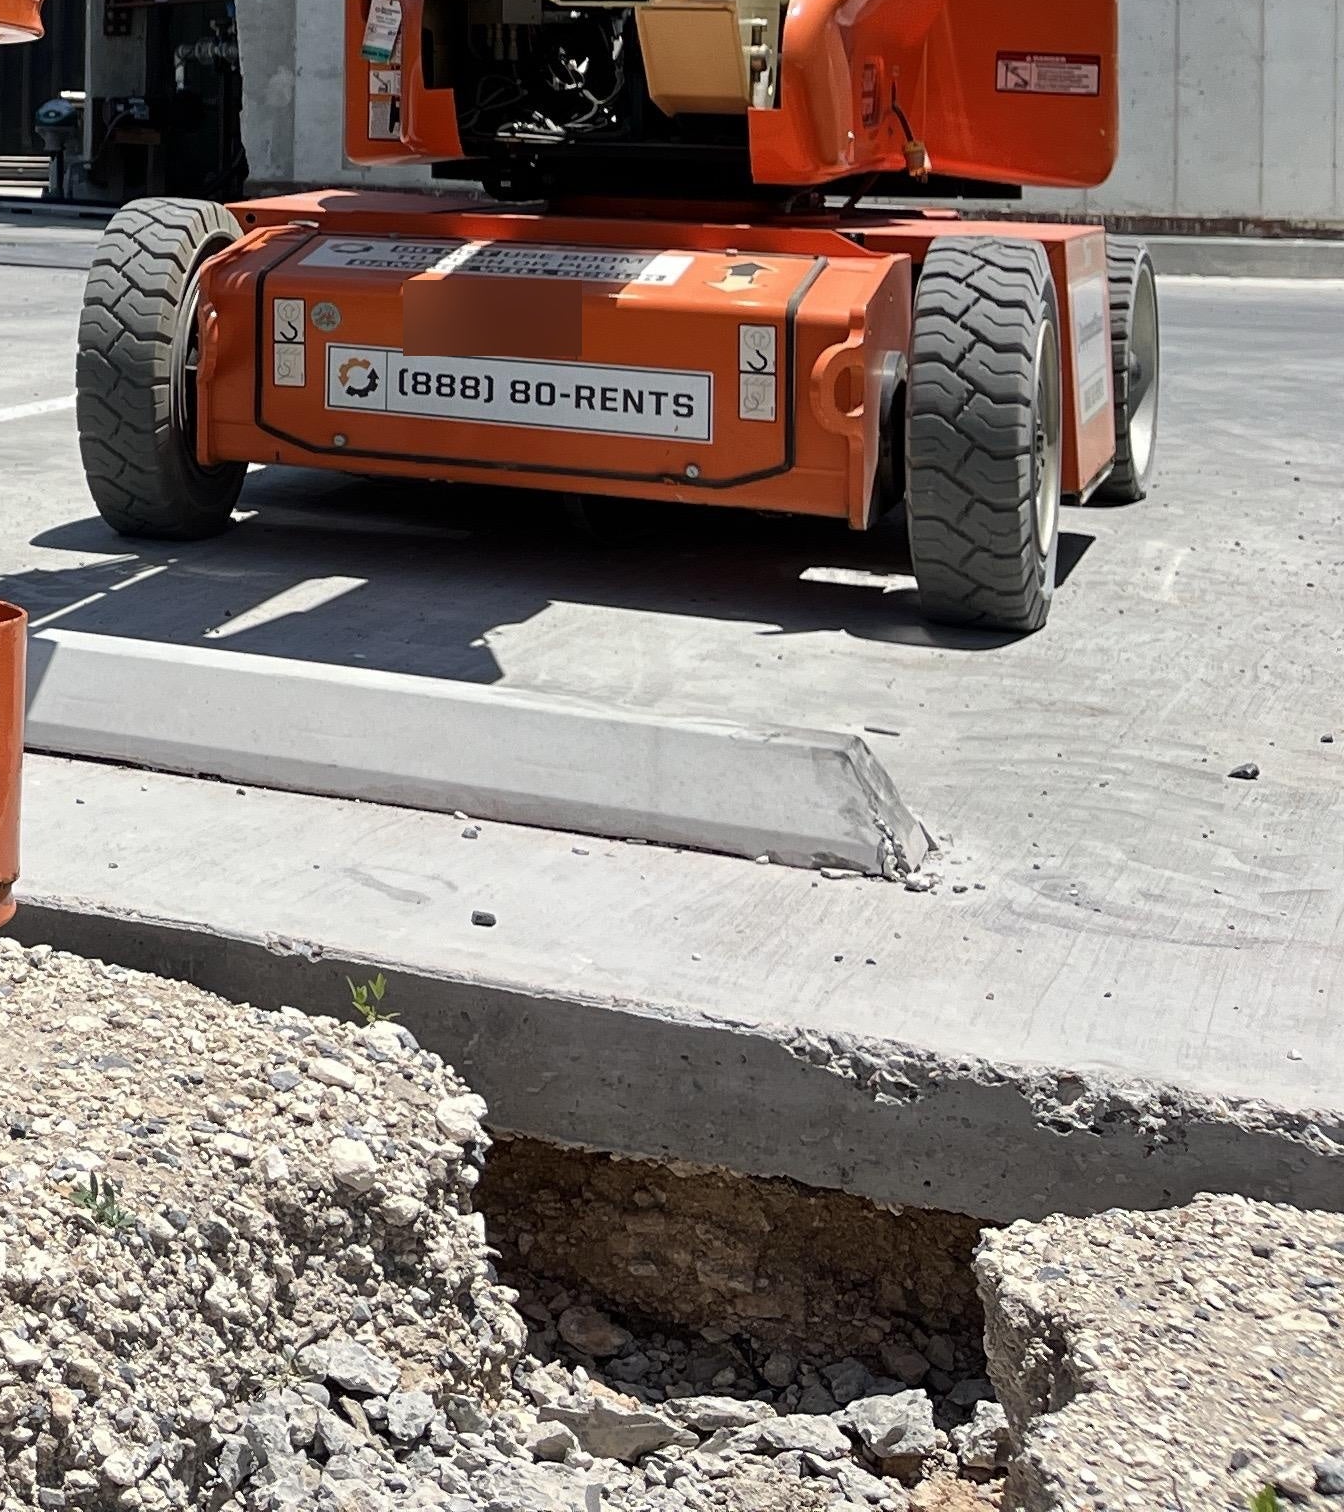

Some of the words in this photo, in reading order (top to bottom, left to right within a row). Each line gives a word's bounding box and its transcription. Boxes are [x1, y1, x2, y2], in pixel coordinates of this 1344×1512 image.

[562, 254, 645, 265] BOOM
[398, 367, 495, 404] (888)
[510, 379, 695, 419] 80-RENTS
